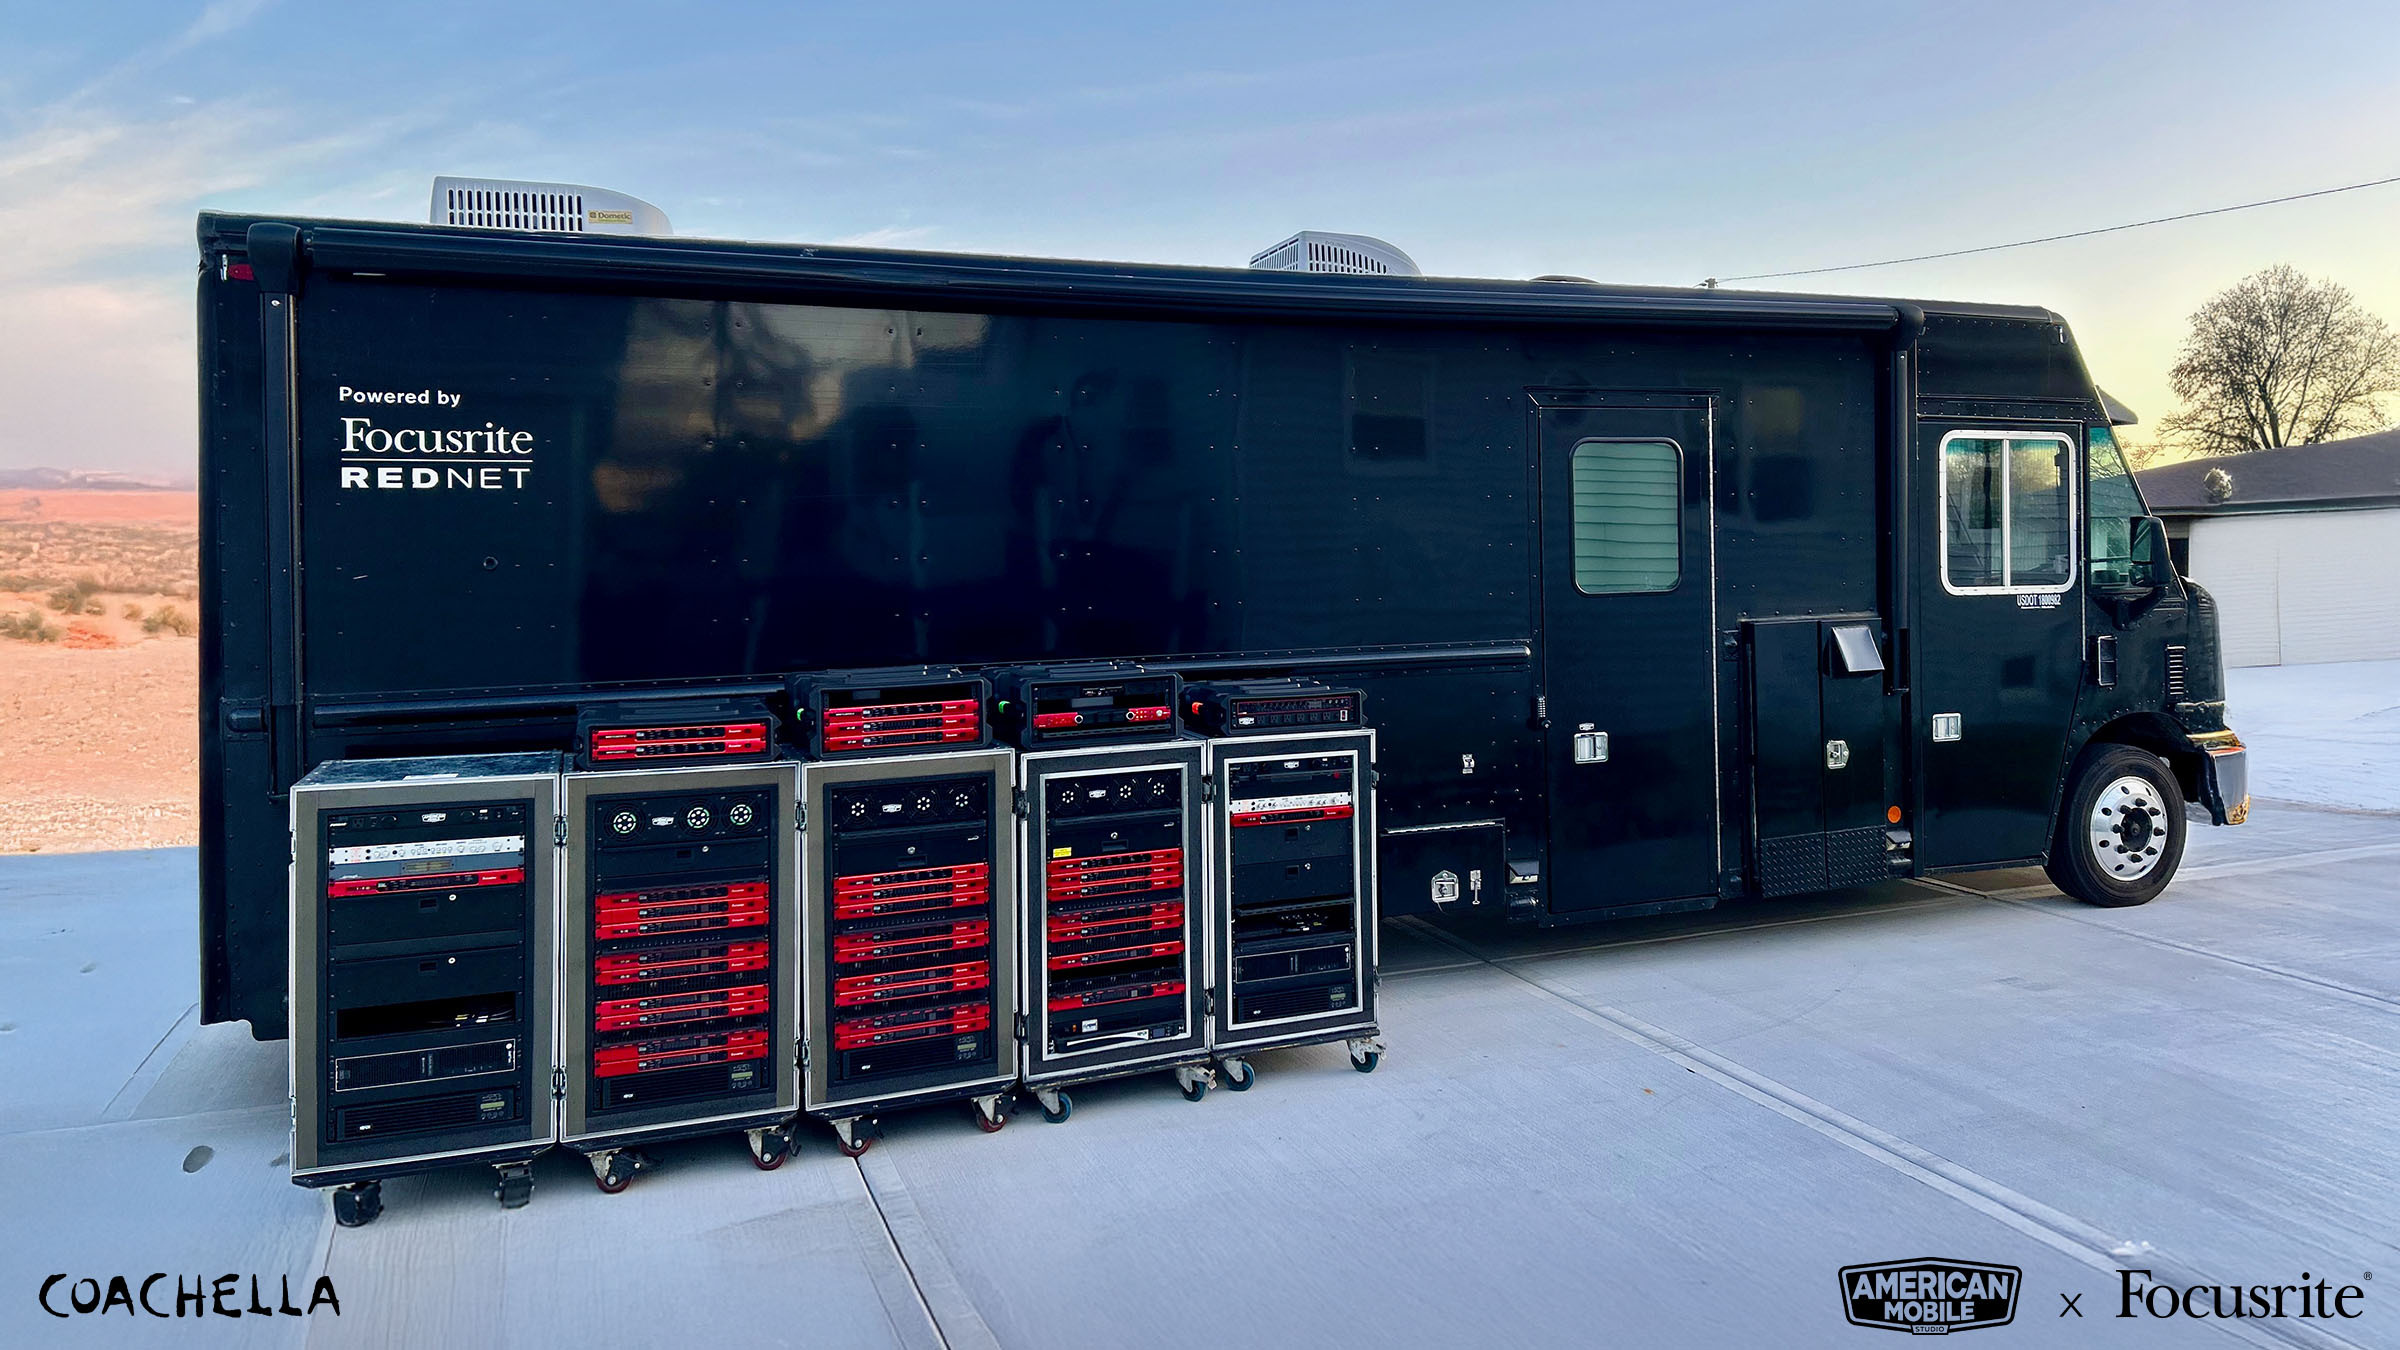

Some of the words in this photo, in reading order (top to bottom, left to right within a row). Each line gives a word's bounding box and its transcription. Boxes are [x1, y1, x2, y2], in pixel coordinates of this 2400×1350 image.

[598, 212, 631, 220] Dometic
[339, 386, 430, 404] Powered
[437, 390, 461, 408] by
[340, 417, 534, 454] Focusrite
[341, 467, 531, 489] REDNET
[2016, 594, 2038, 607] USDOT
